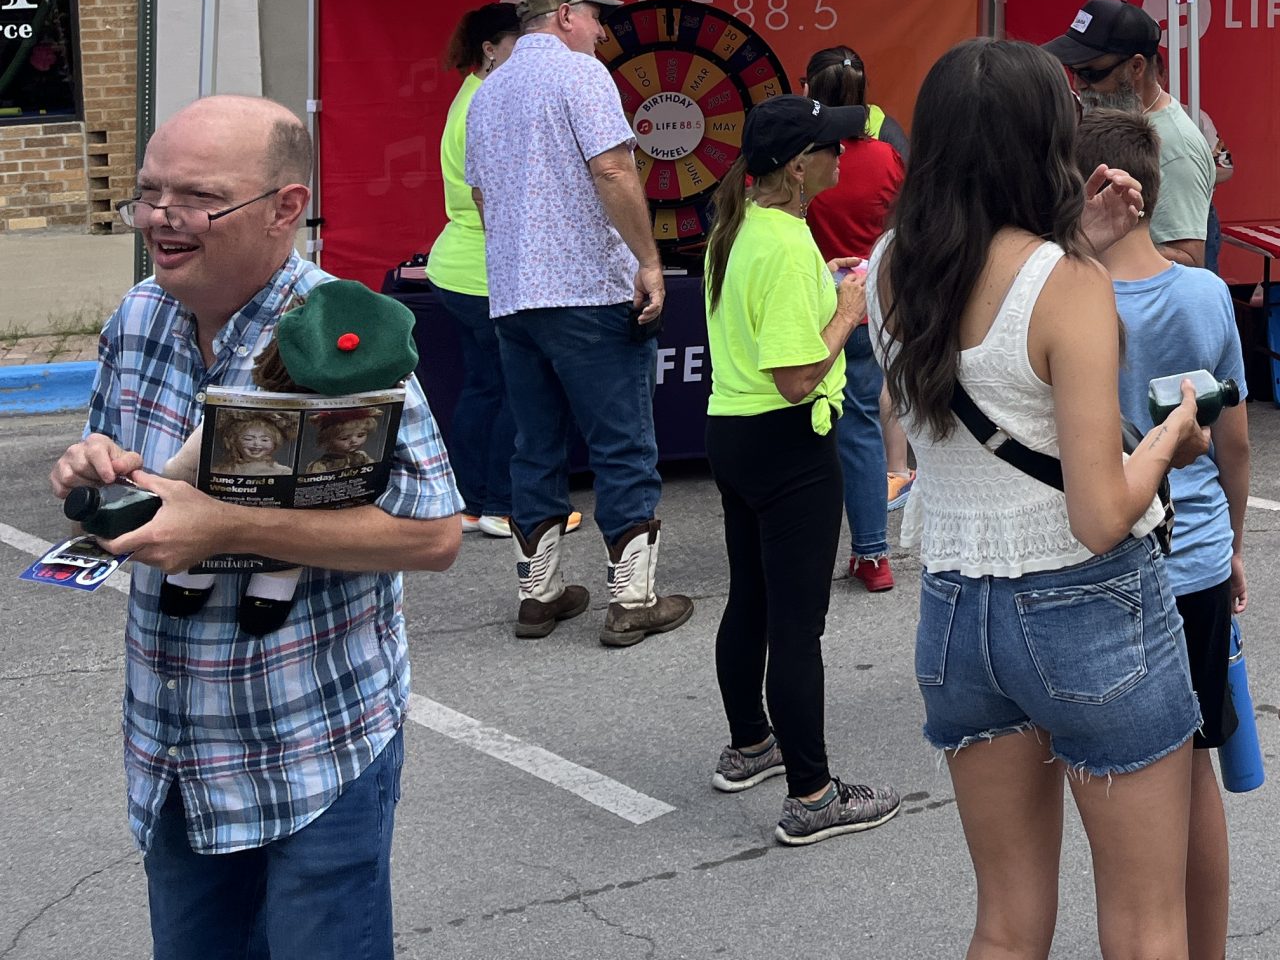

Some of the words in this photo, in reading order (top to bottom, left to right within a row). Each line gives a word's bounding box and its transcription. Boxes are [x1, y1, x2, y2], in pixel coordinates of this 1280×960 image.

[724, 29, 738, 41] 30
[723, 43, 736, 54] 31
[634, 66, 651, 88] OCT
[667, 58, 679, 83] AUG
[689, 67, 710, 92] MAR
[642, 93, 694, 114] BIRTHDAY
[655, 121, 678, 132] LIFE
[679, 120, 702, 130] 88.5
[712, 122, 737, 132] MAY
[650, 145, 689, 159] WHEEL
[704, 144, 728, 162] DEC
[658, 169, 671, 191] FEB
[684, 161, 704, 187] JUNE
[661, 222, 669, 234] 5
[656, 345, 705, 385] FE
[338, 468, 360, 479] July
[360, 465, 375, 474] 20
[209, 476, 235, 485] June
[236, 477, 244, 485] 7
[245, 477, 266, 485] and
[267, 477, 275, 485] 8
[209, 484, 258, 494] Weekend
